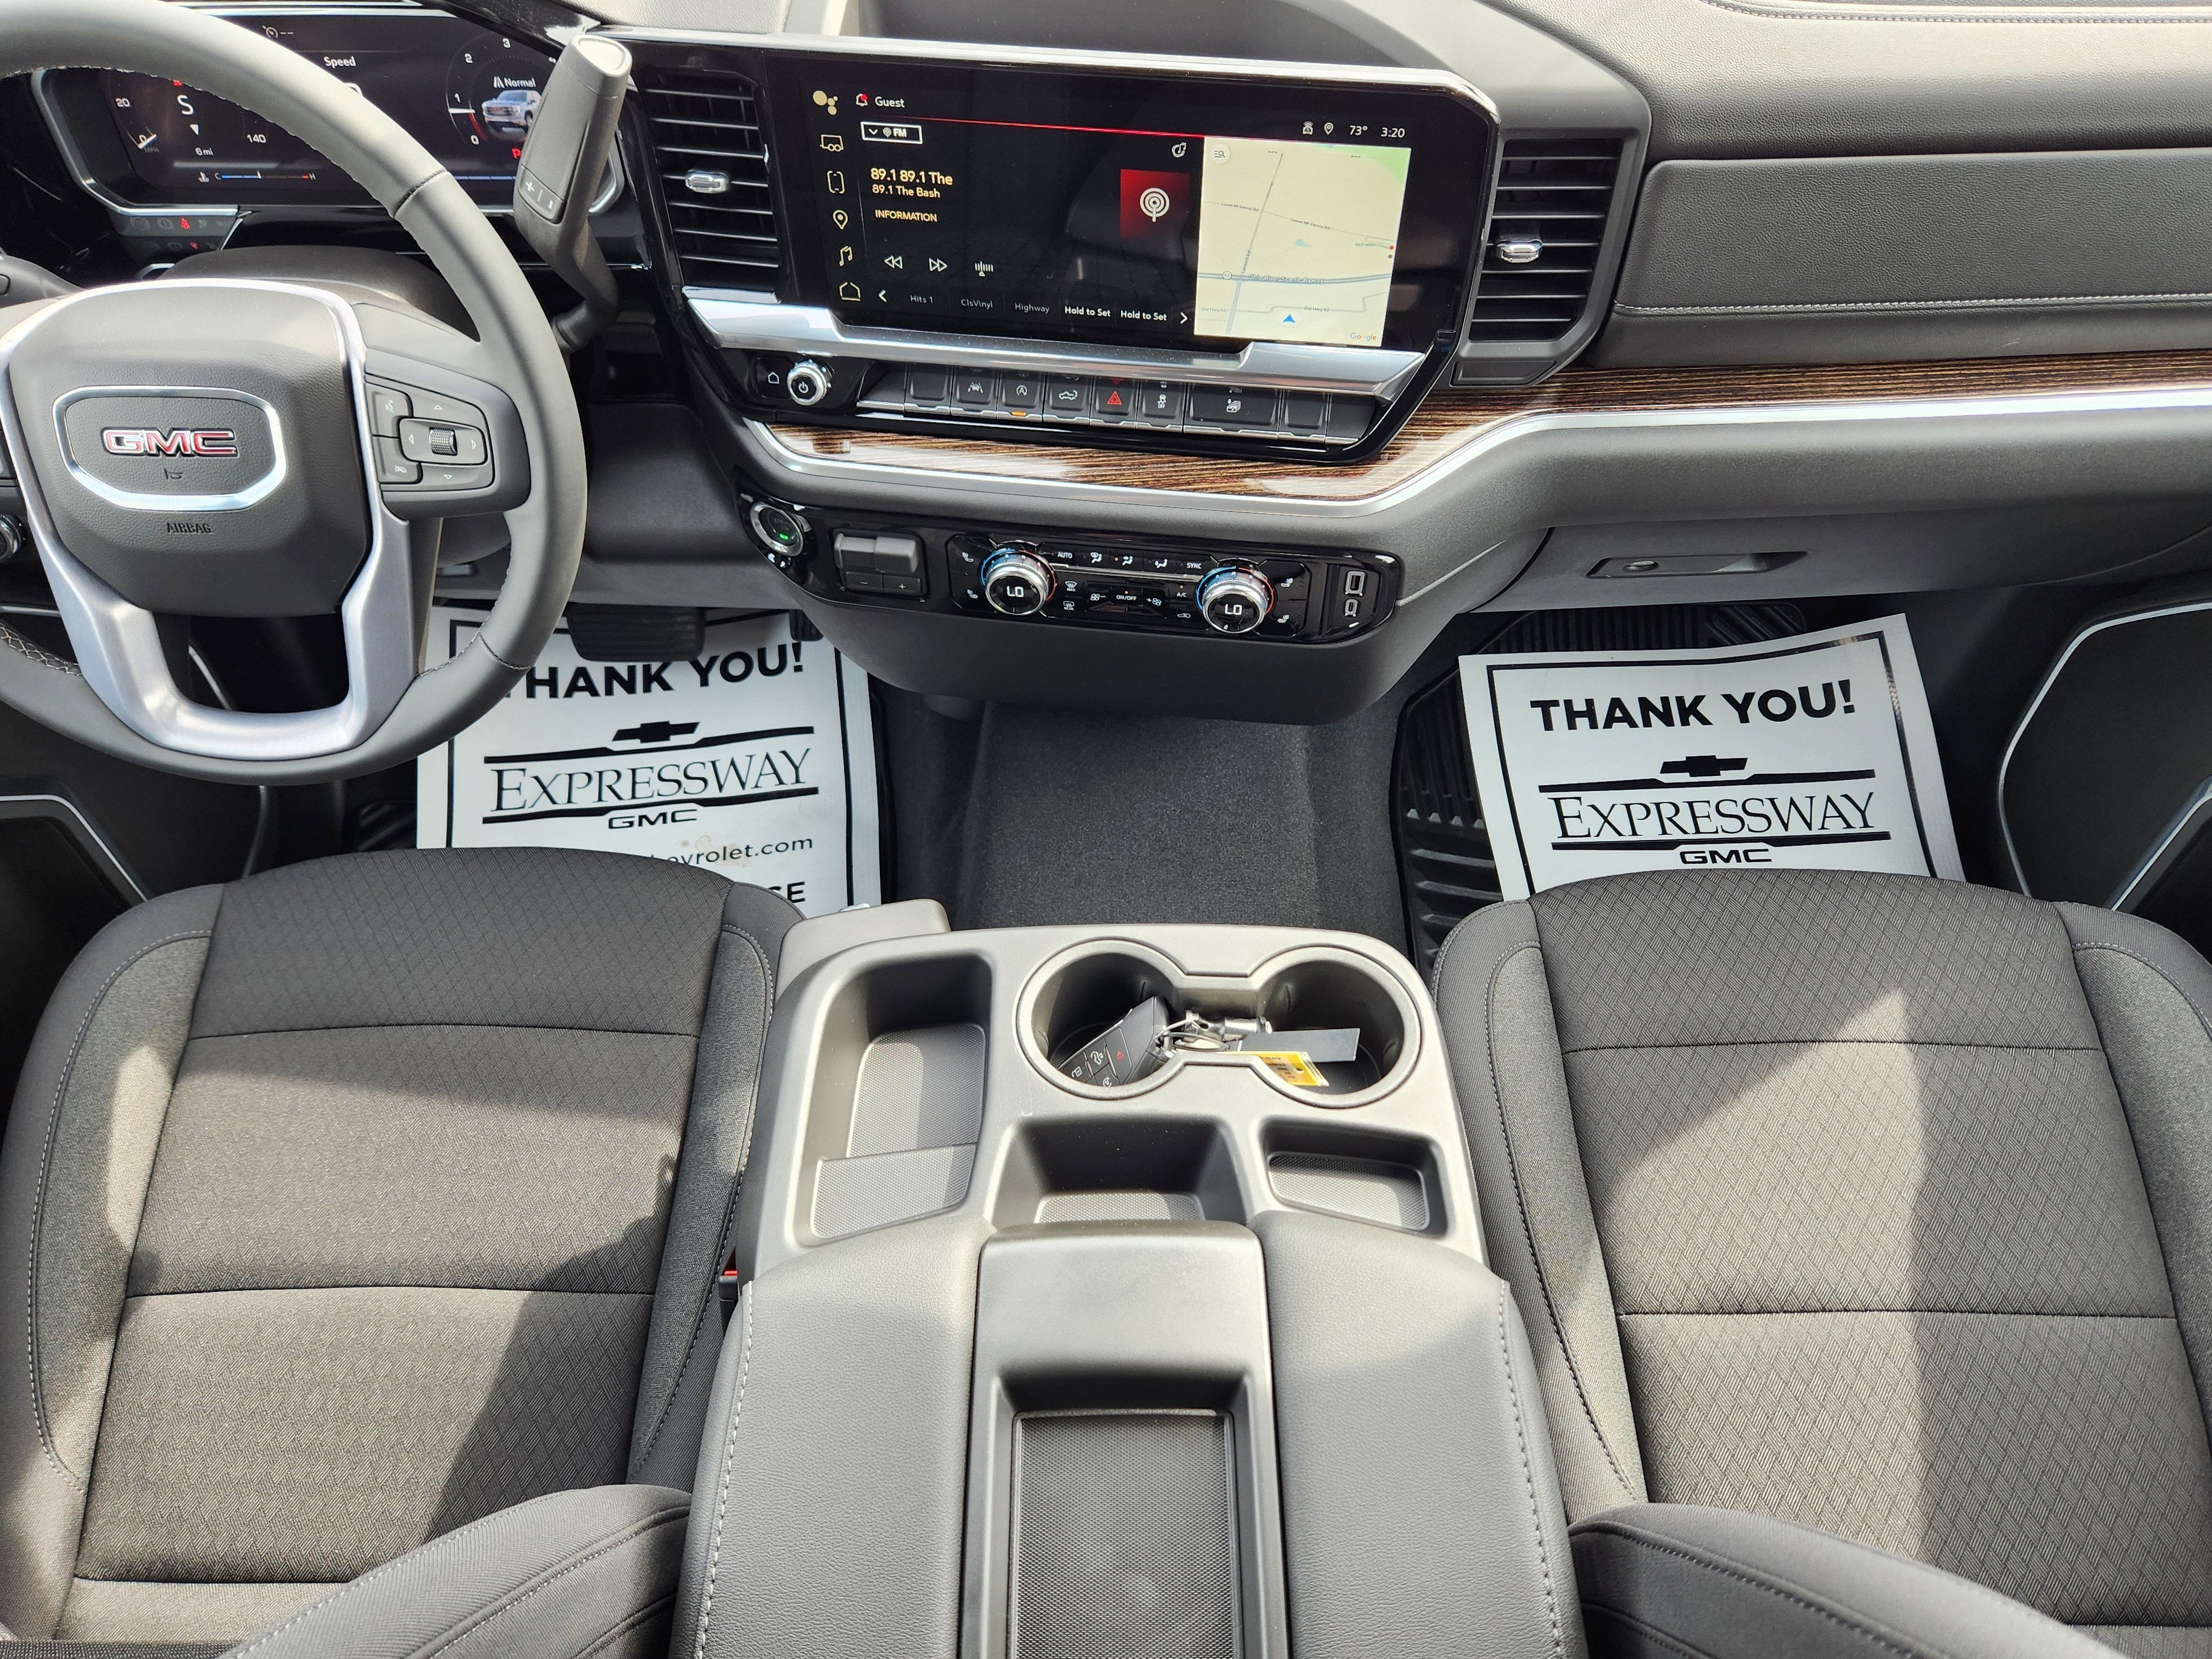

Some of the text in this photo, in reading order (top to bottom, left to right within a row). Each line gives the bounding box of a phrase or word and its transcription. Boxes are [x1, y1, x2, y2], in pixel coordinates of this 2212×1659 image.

[502, 38, 511, 48] 3
[324, 56, 356, 69] Speed
[465, 53, 473, 63] 2
[504, 77, 536, 87] Normal
[115, 98, 131, 107] 20
[455, 93, 461, 103] 1
[874, 96, 905, 108] Guest
[177, 95, 194, 115] S
[247, 134, 267, 143] 140
[893, 128, 907, 137] FM
[1380, 127, 1405, 138] 3:20
[471, 135, 479, 145] 0
[870, 168, 953, 185] 89.1 89.1 The
[872, 184, 941, 198] 89.1 The Bash
[875, 210, 937, 222] INFORMATION
[910, 295, 927, 303] Hits
[1015, 302, 1050, 314] Highway
[1065, 306, 1111, 317] Hold to Set
[1120, 310, 1167, 321] Hold to Set
[1350, 332, 1377, 342] Google
[101, 426, 238, 457] GMC
[167, 522, 212, 534] AIRBAG
[1006, 586, 1024, 598] LO
[1224, 603, 1243, 615] LO
[505, 641, 804, 699] HANK YOU!
[1530, 679, 1855, 731] THANK YOU!
[490, 748, 811, 812] EXPRESSWAY
[608, 809, 698, 830] GMC
[1547, 791, 1875, 839] EXPRESSWAY
[1679, 848, 1772, 865] GMC
